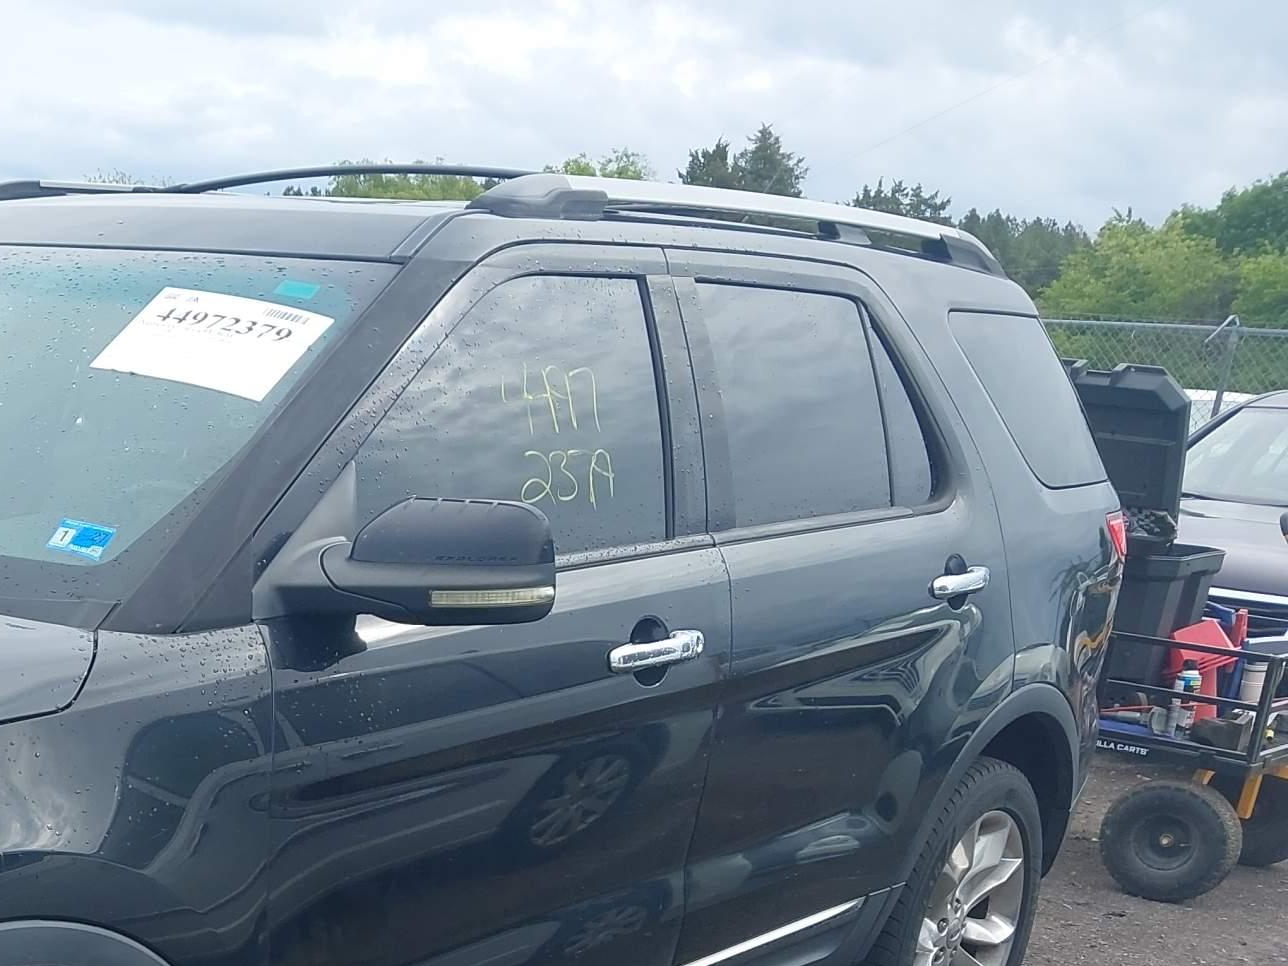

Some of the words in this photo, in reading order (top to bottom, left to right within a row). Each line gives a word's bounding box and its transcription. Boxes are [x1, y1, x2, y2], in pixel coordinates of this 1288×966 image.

[156, 307, 293, 342] 44972379
[58, 529, 70, 542] 1
[1116, 743, 1148, 756] CARTS
